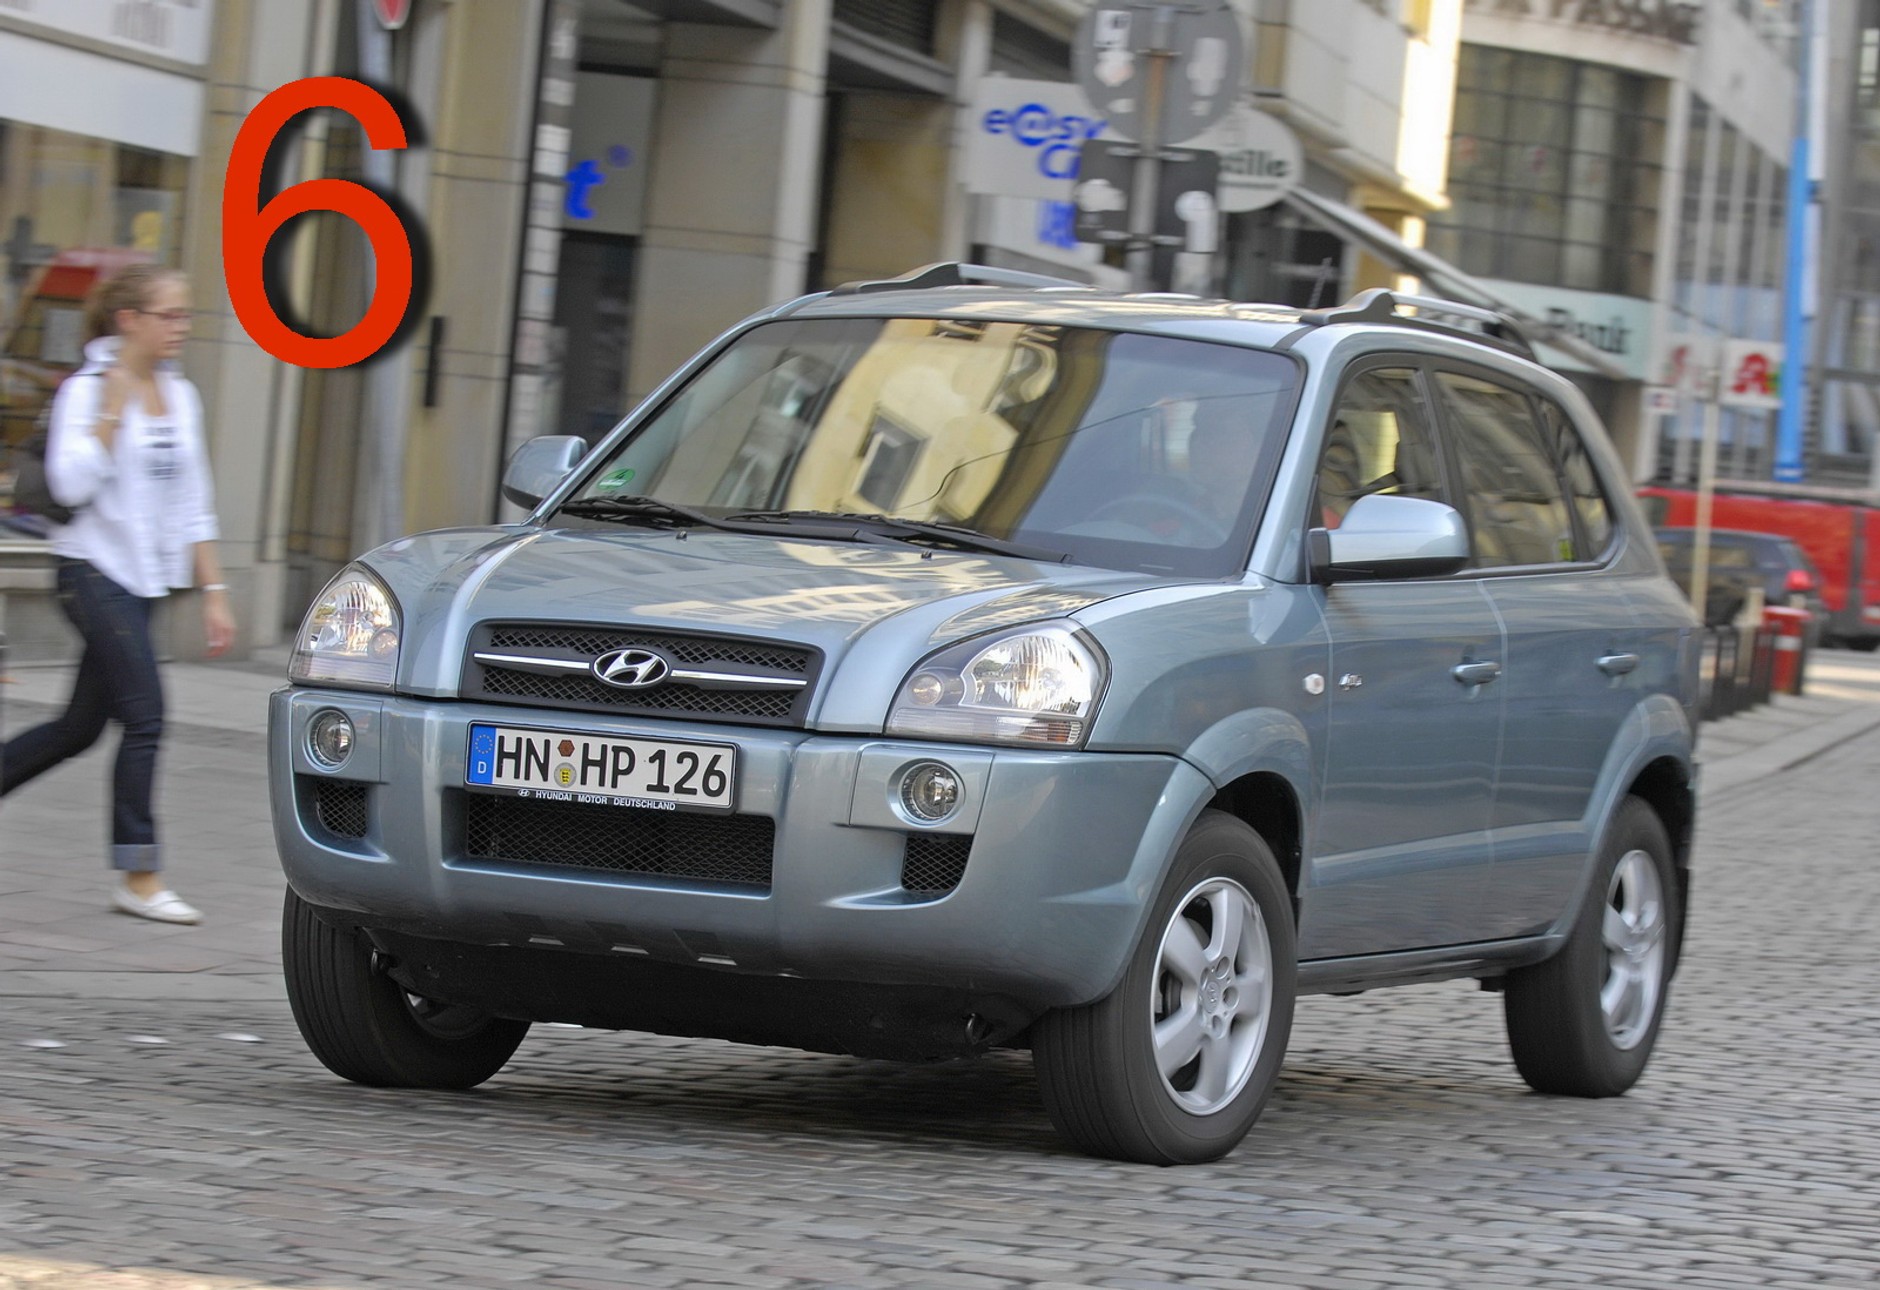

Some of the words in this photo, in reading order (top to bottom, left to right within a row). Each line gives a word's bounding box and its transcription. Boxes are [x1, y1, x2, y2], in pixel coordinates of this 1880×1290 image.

[477, 761, 487, 774] D
[495, 735, 551, 782] HN
[580, 742, 636, 789] HP
[646, 749, 727, 797] 126
[535, 790, 572, 802] HYUNDAI
[577, 794, 608, 805] MOTOR
[613, 797, 676, 811] DEUTSCHLAND
